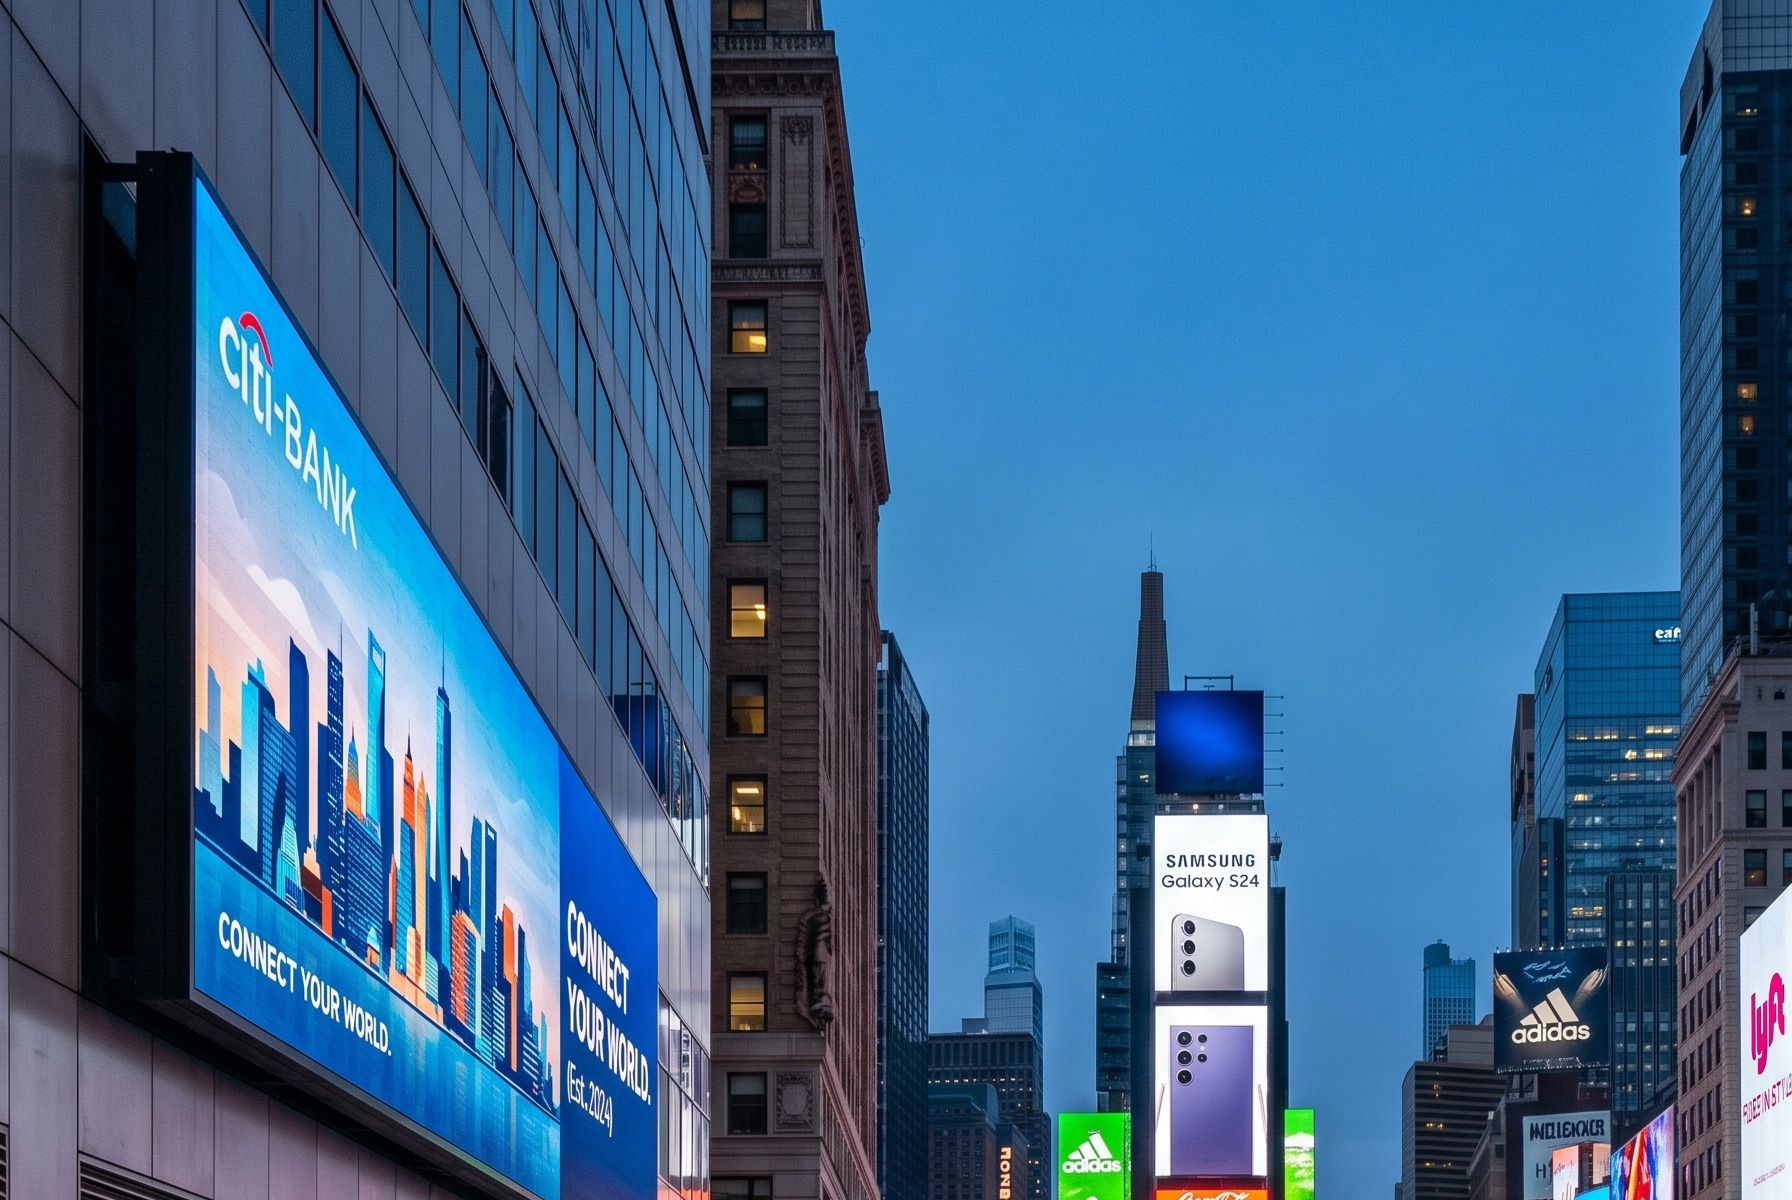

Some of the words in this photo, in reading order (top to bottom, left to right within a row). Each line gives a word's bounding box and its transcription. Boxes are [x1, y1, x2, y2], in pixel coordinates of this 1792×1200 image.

[1161, 874, 1224, 891] Galaxy
[1229, 874, 1259, 888] S24
[1166, 854, 1255, 868] SAMSUNG
[218, 911, 298, 993] CONNECT
[300, 966, 341, 1023] YOUR
[342, 996, 392, 1057] WORLD.
[566, 900, 630, 1015] CONNECT
[566, 976, 605, 1063] YOUR
[606, 1017, 652, 1106] WORLD.
[1511, 1022, 1591, 1044] adidas
[1750, 972, 1785, 1076] lyft
[1061, 1159, 1121, 1174] adidas
